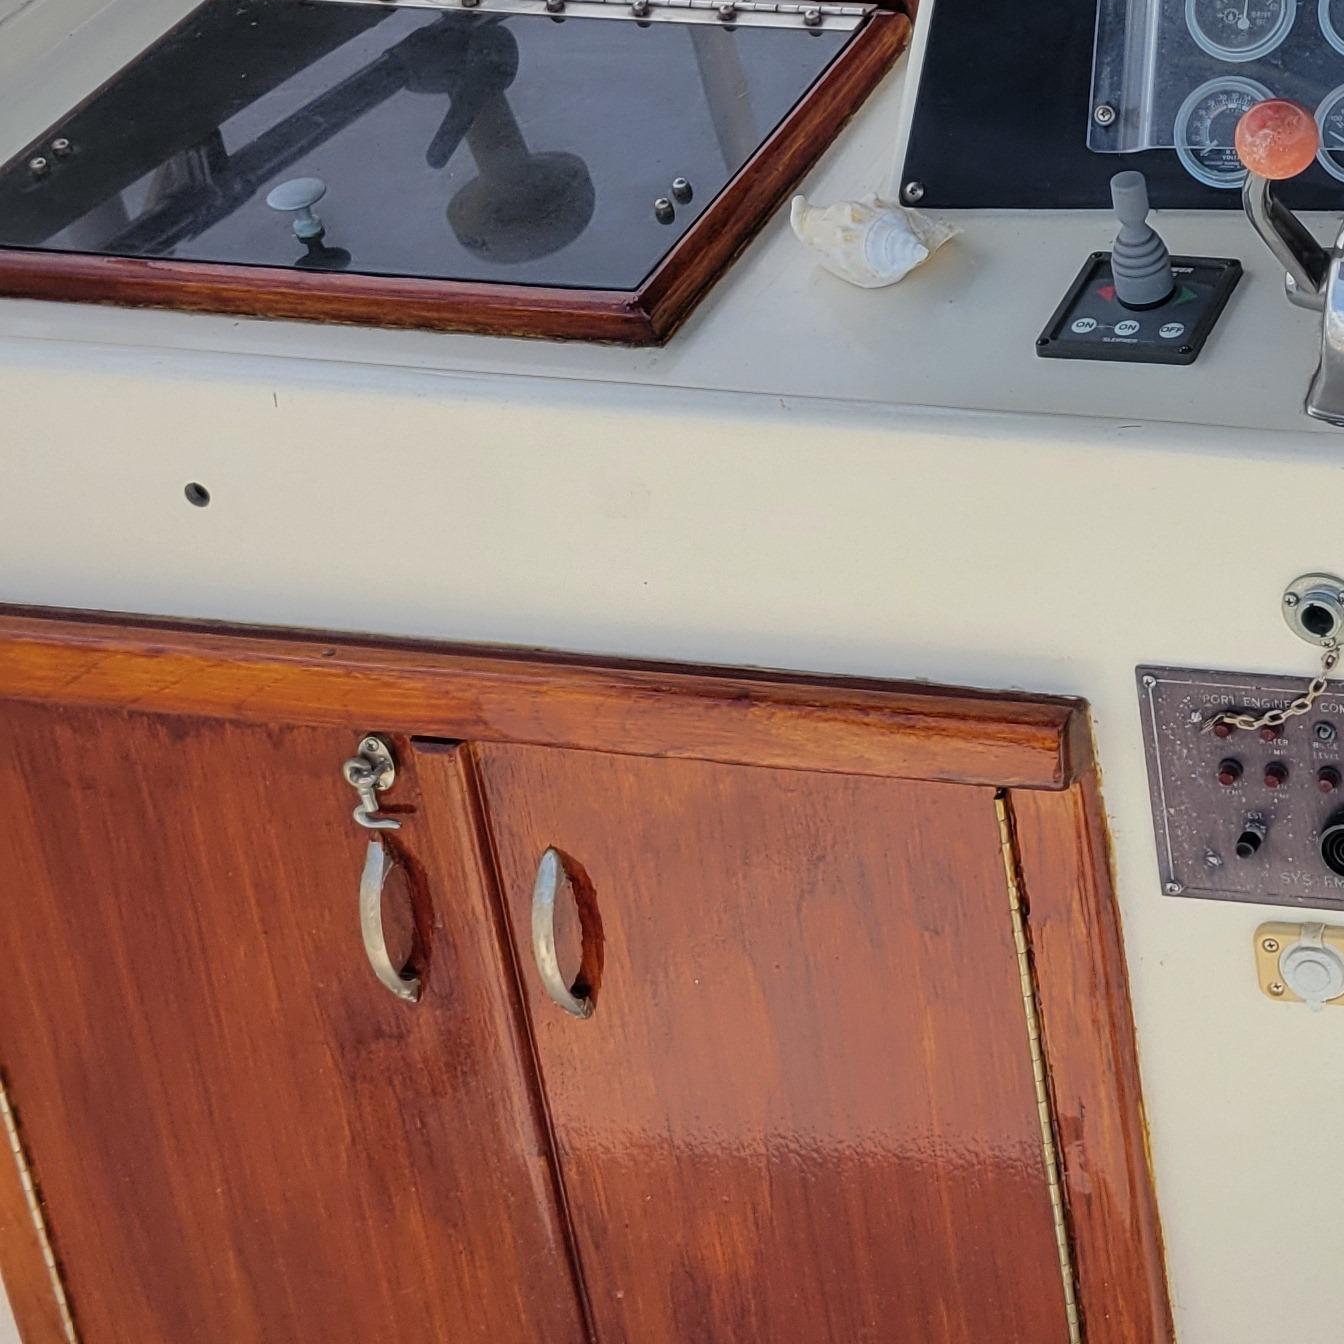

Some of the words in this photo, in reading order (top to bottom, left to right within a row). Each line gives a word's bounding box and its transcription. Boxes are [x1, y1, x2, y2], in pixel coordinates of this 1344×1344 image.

[1075, 321, 1095, 329] ON
[1118, 323, 1137, 331] ON
[1160, 326, 1183, 334] OFF
[1202, 694, 1236, 705] PORT
[1243, 696, 1292, 709] ENGINE
